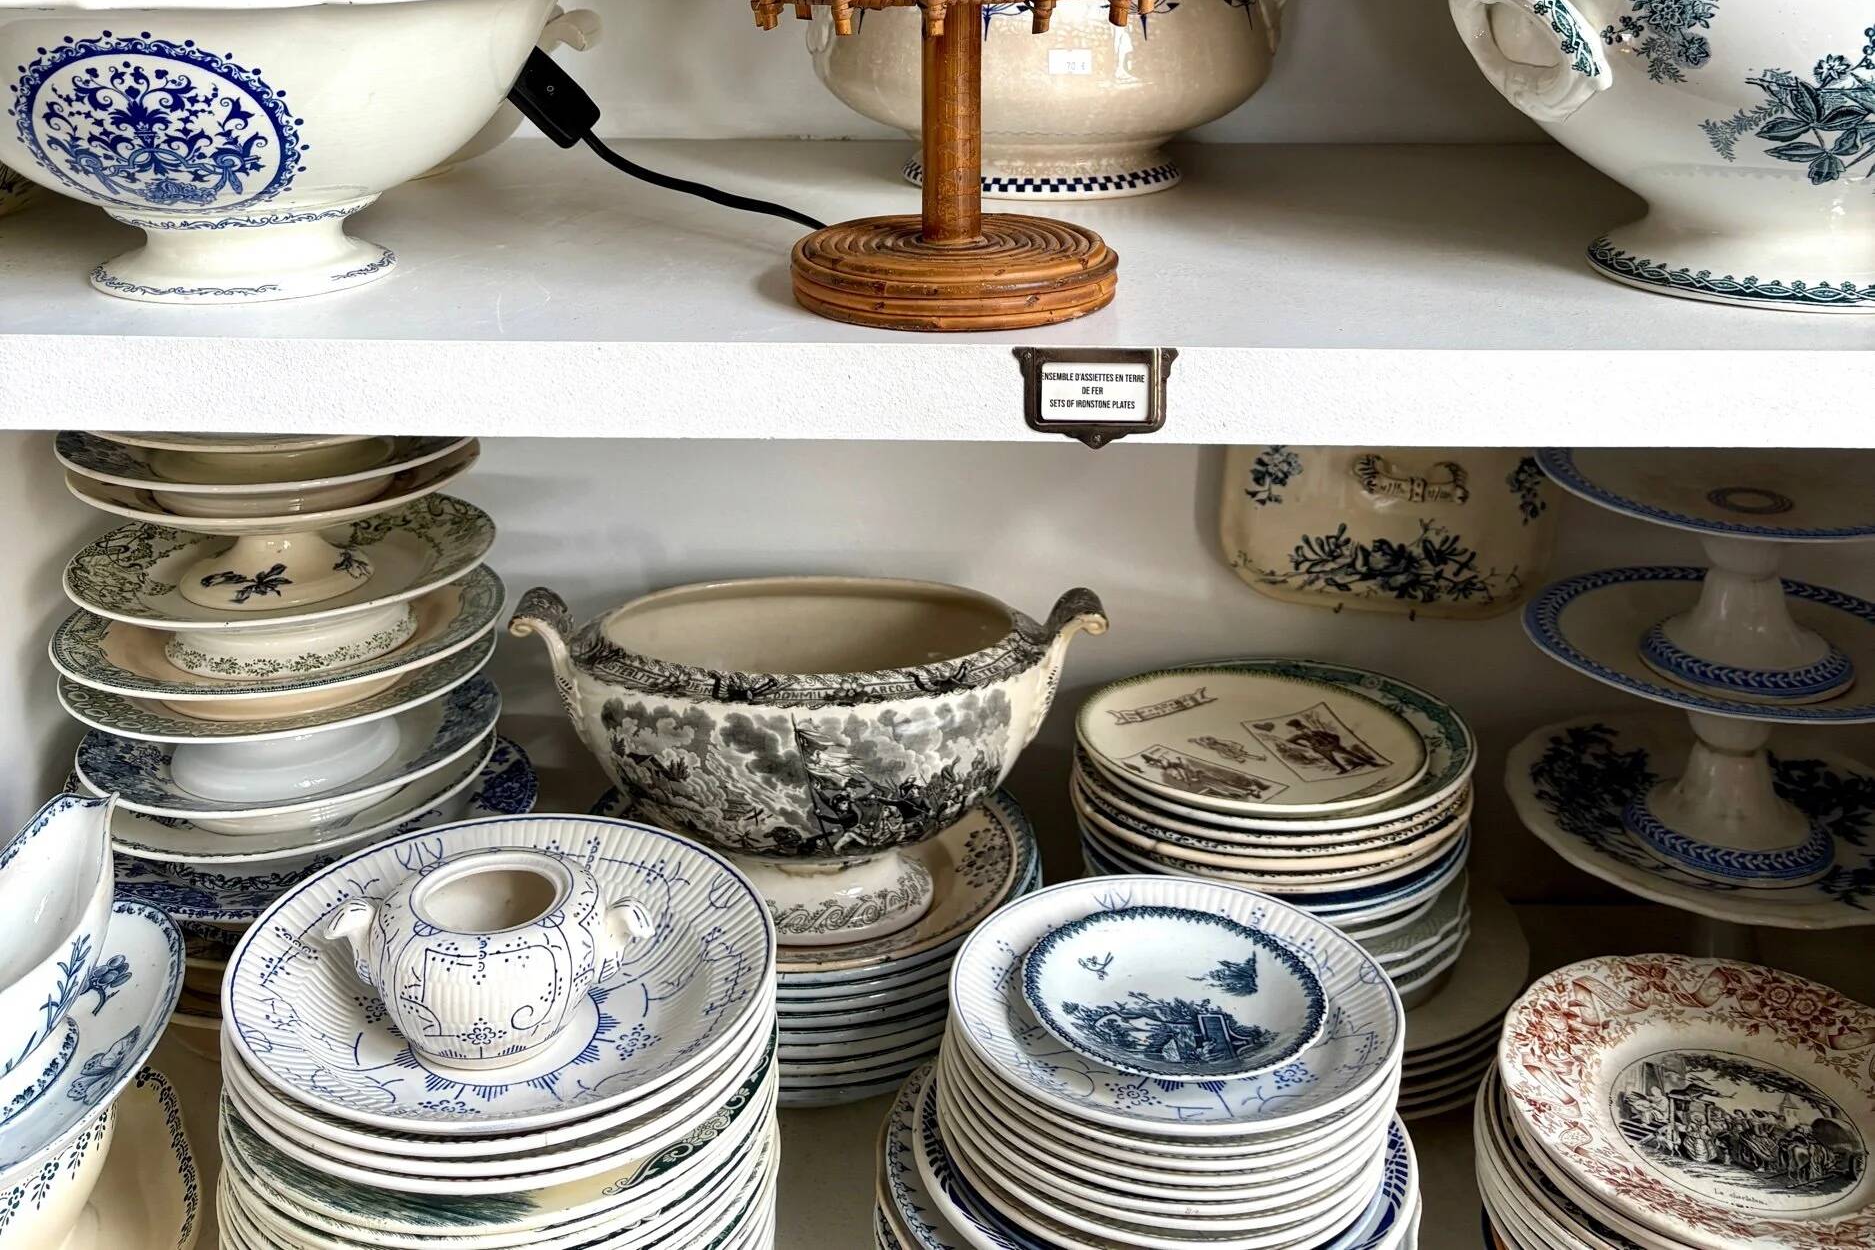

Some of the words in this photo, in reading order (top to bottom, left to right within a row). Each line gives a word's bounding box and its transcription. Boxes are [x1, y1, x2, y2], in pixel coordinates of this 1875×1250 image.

[1042, 372, 1073, 383] ENSEMBLE
[1075, 373, 1113, 383] D'ASSIETTES
[1115, 375, 1124, 384] EN
[1125, 375, 1145, 384] TERRE
[1082, 386, 1090, 395] DE
[1091, 386, 1104, 396] FER
[1050, 399, 1065, 409] SETS
[1066, 400, 1075, 409] OF
[1076, 400, 1111, 410] IRONSTONE
[1112, 401, 1136, 411] PLATES
